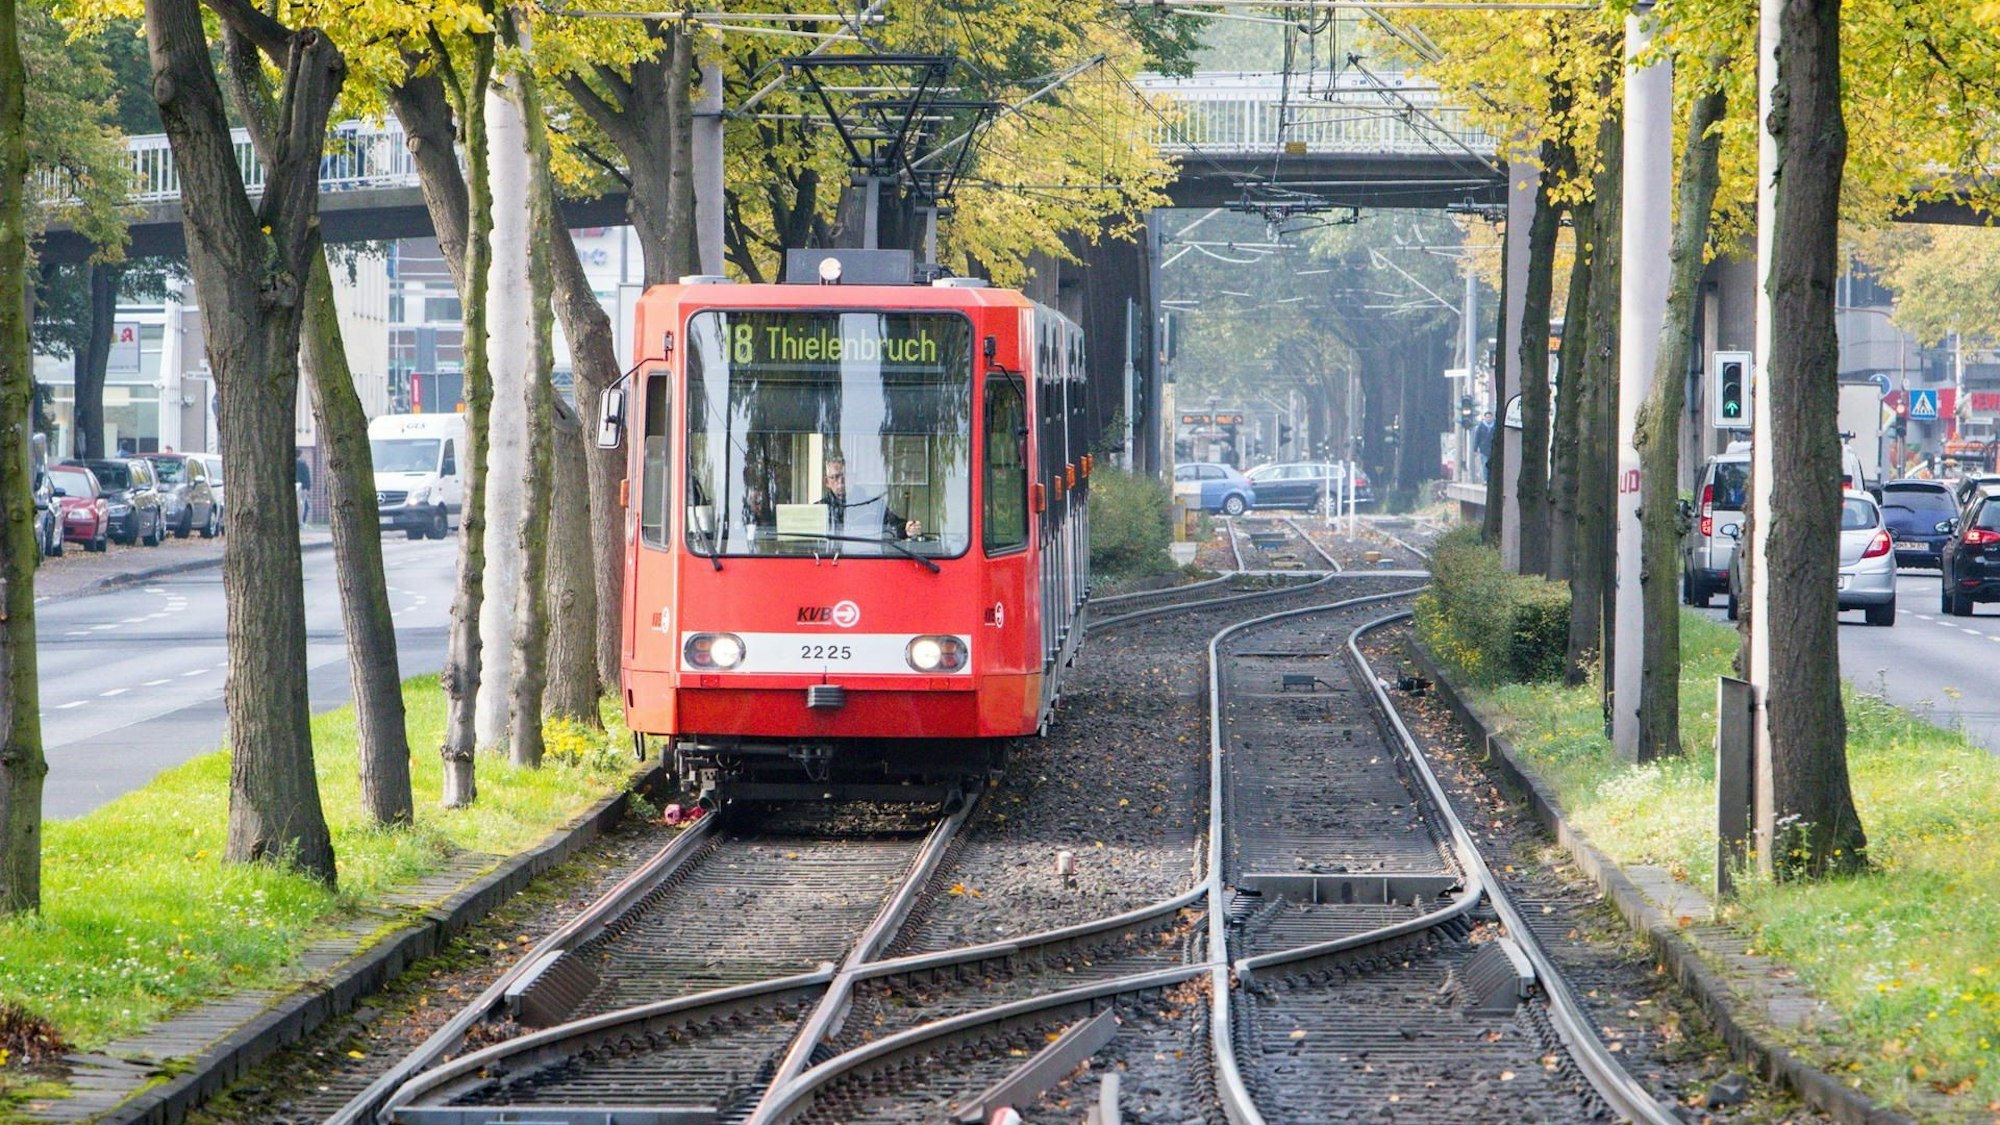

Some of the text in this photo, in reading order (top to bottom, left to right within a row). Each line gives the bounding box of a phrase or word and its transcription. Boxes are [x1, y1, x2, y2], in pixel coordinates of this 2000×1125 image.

[766, 327, 937, 362] Thielenbruch
[797, 606, 833, 622] KVB
[801, 645, 852, 660] 2225
